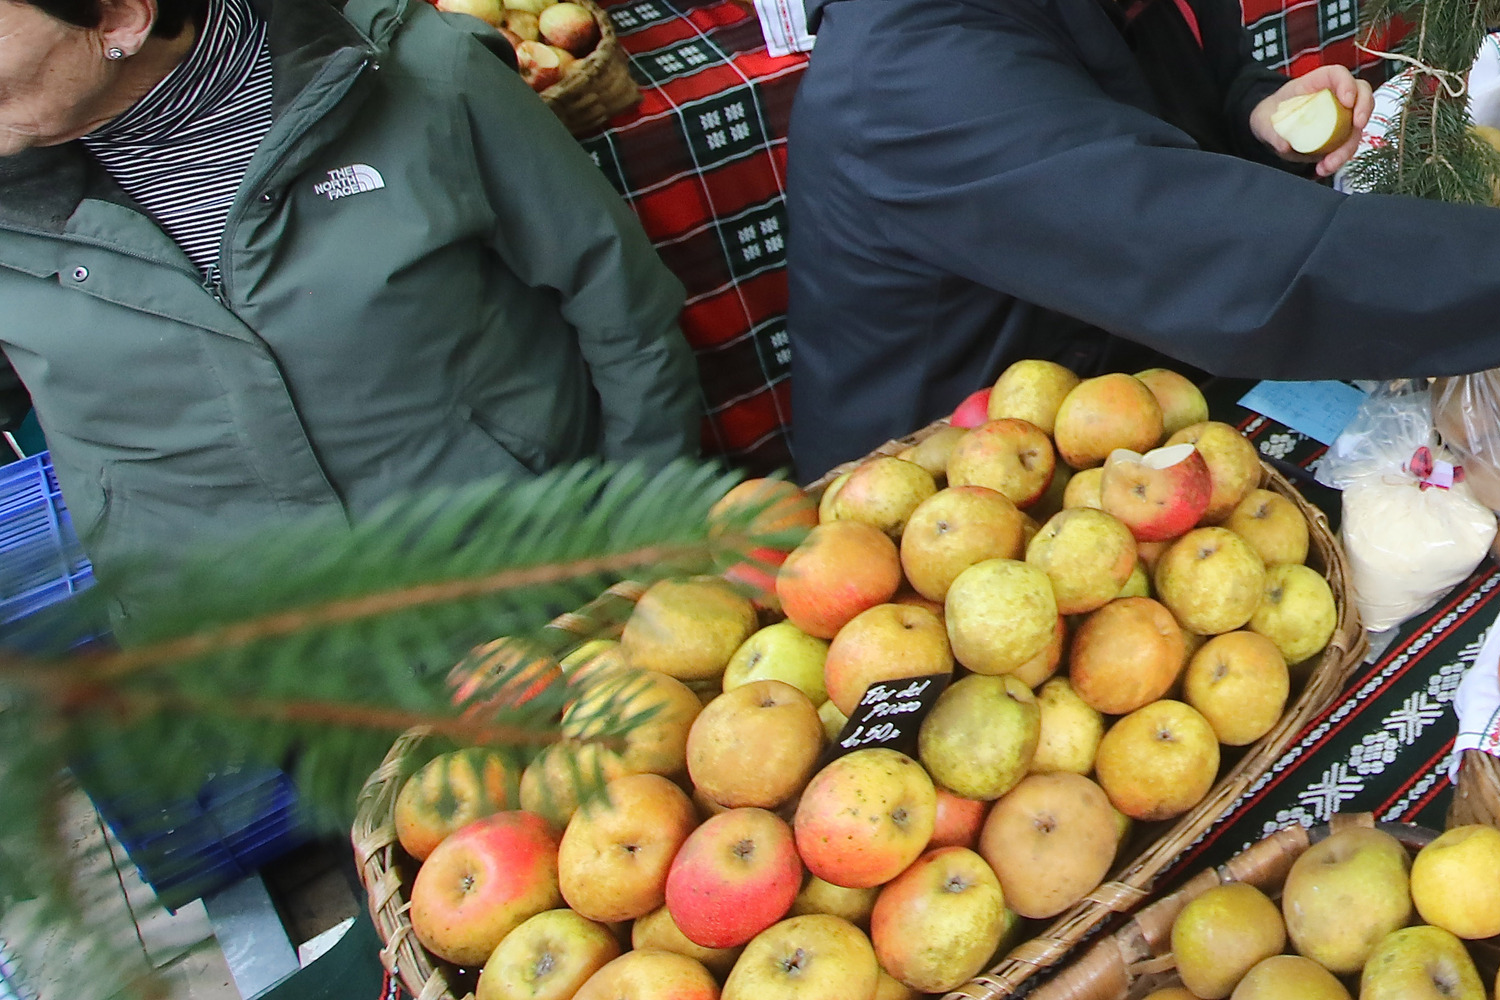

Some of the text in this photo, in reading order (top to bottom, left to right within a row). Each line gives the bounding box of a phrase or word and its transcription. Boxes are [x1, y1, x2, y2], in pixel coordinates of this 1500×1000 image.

[327, 165, 354, 181] THE
[313, 175, 357, 195] NORTH
[328, 184, 361, 201] FACE
